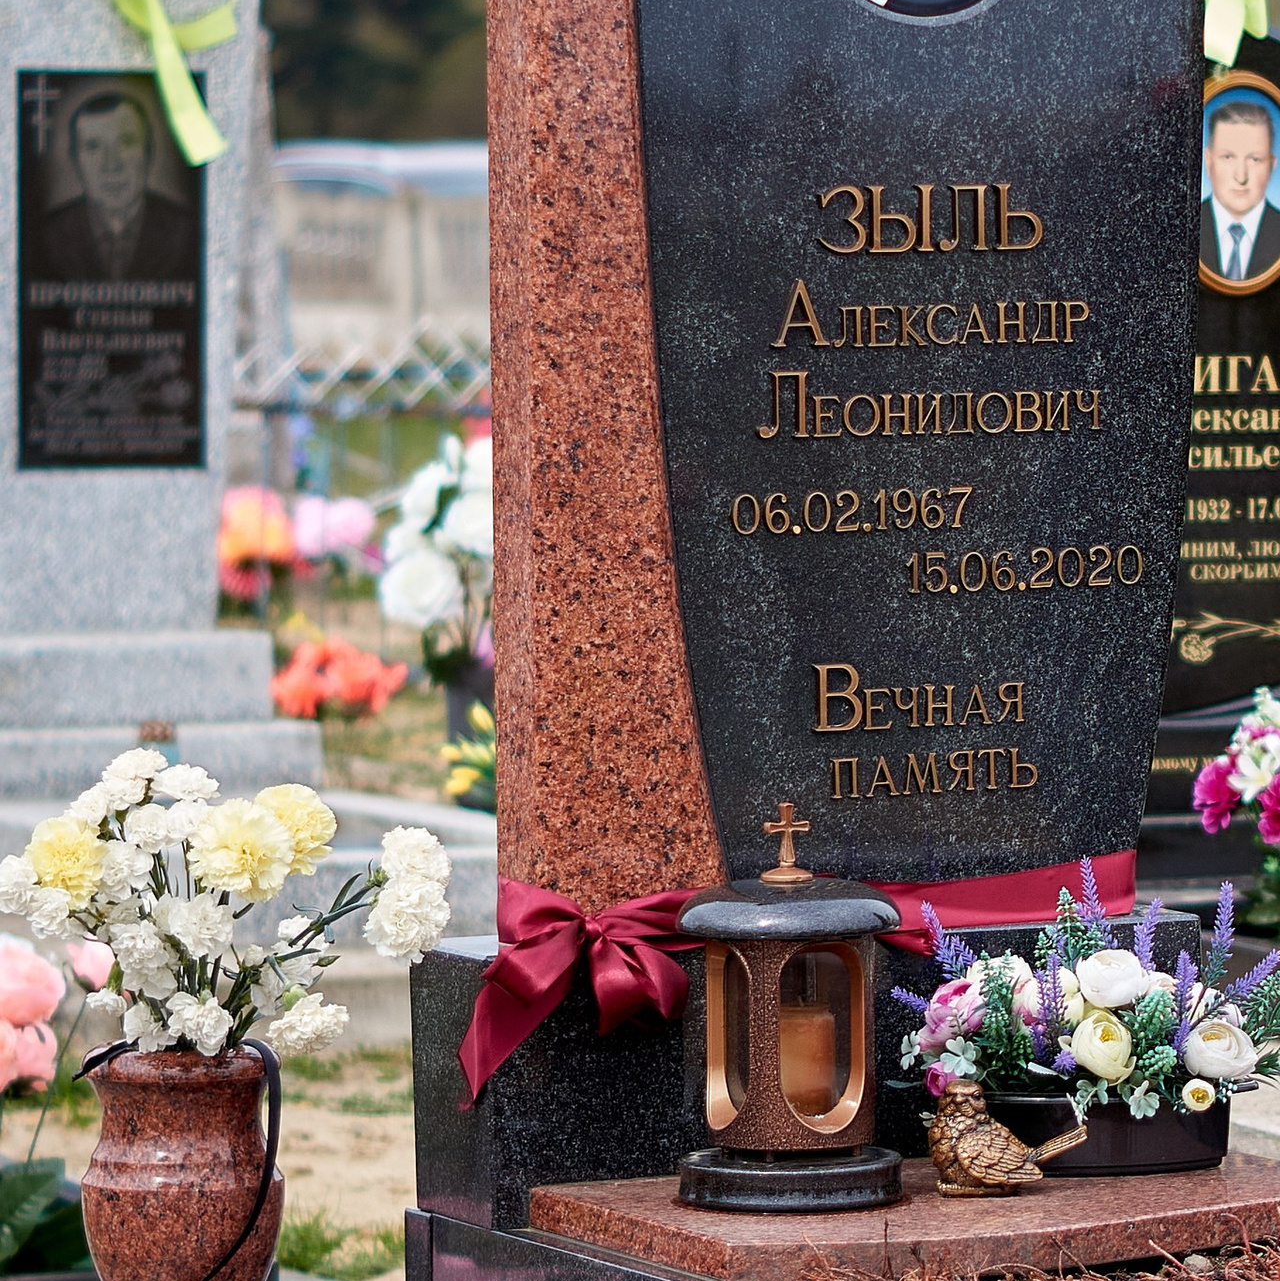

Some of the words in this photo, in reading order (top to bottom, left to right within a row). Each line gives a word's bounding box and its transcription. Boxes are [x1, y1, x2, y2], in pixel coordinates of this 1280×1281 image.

[814, 183, 1044, 255] ЗЫЛЬ
[730, 487, 973, 535] 06.02.1967
[905, 545, 1144, 594] 15.06.2020
